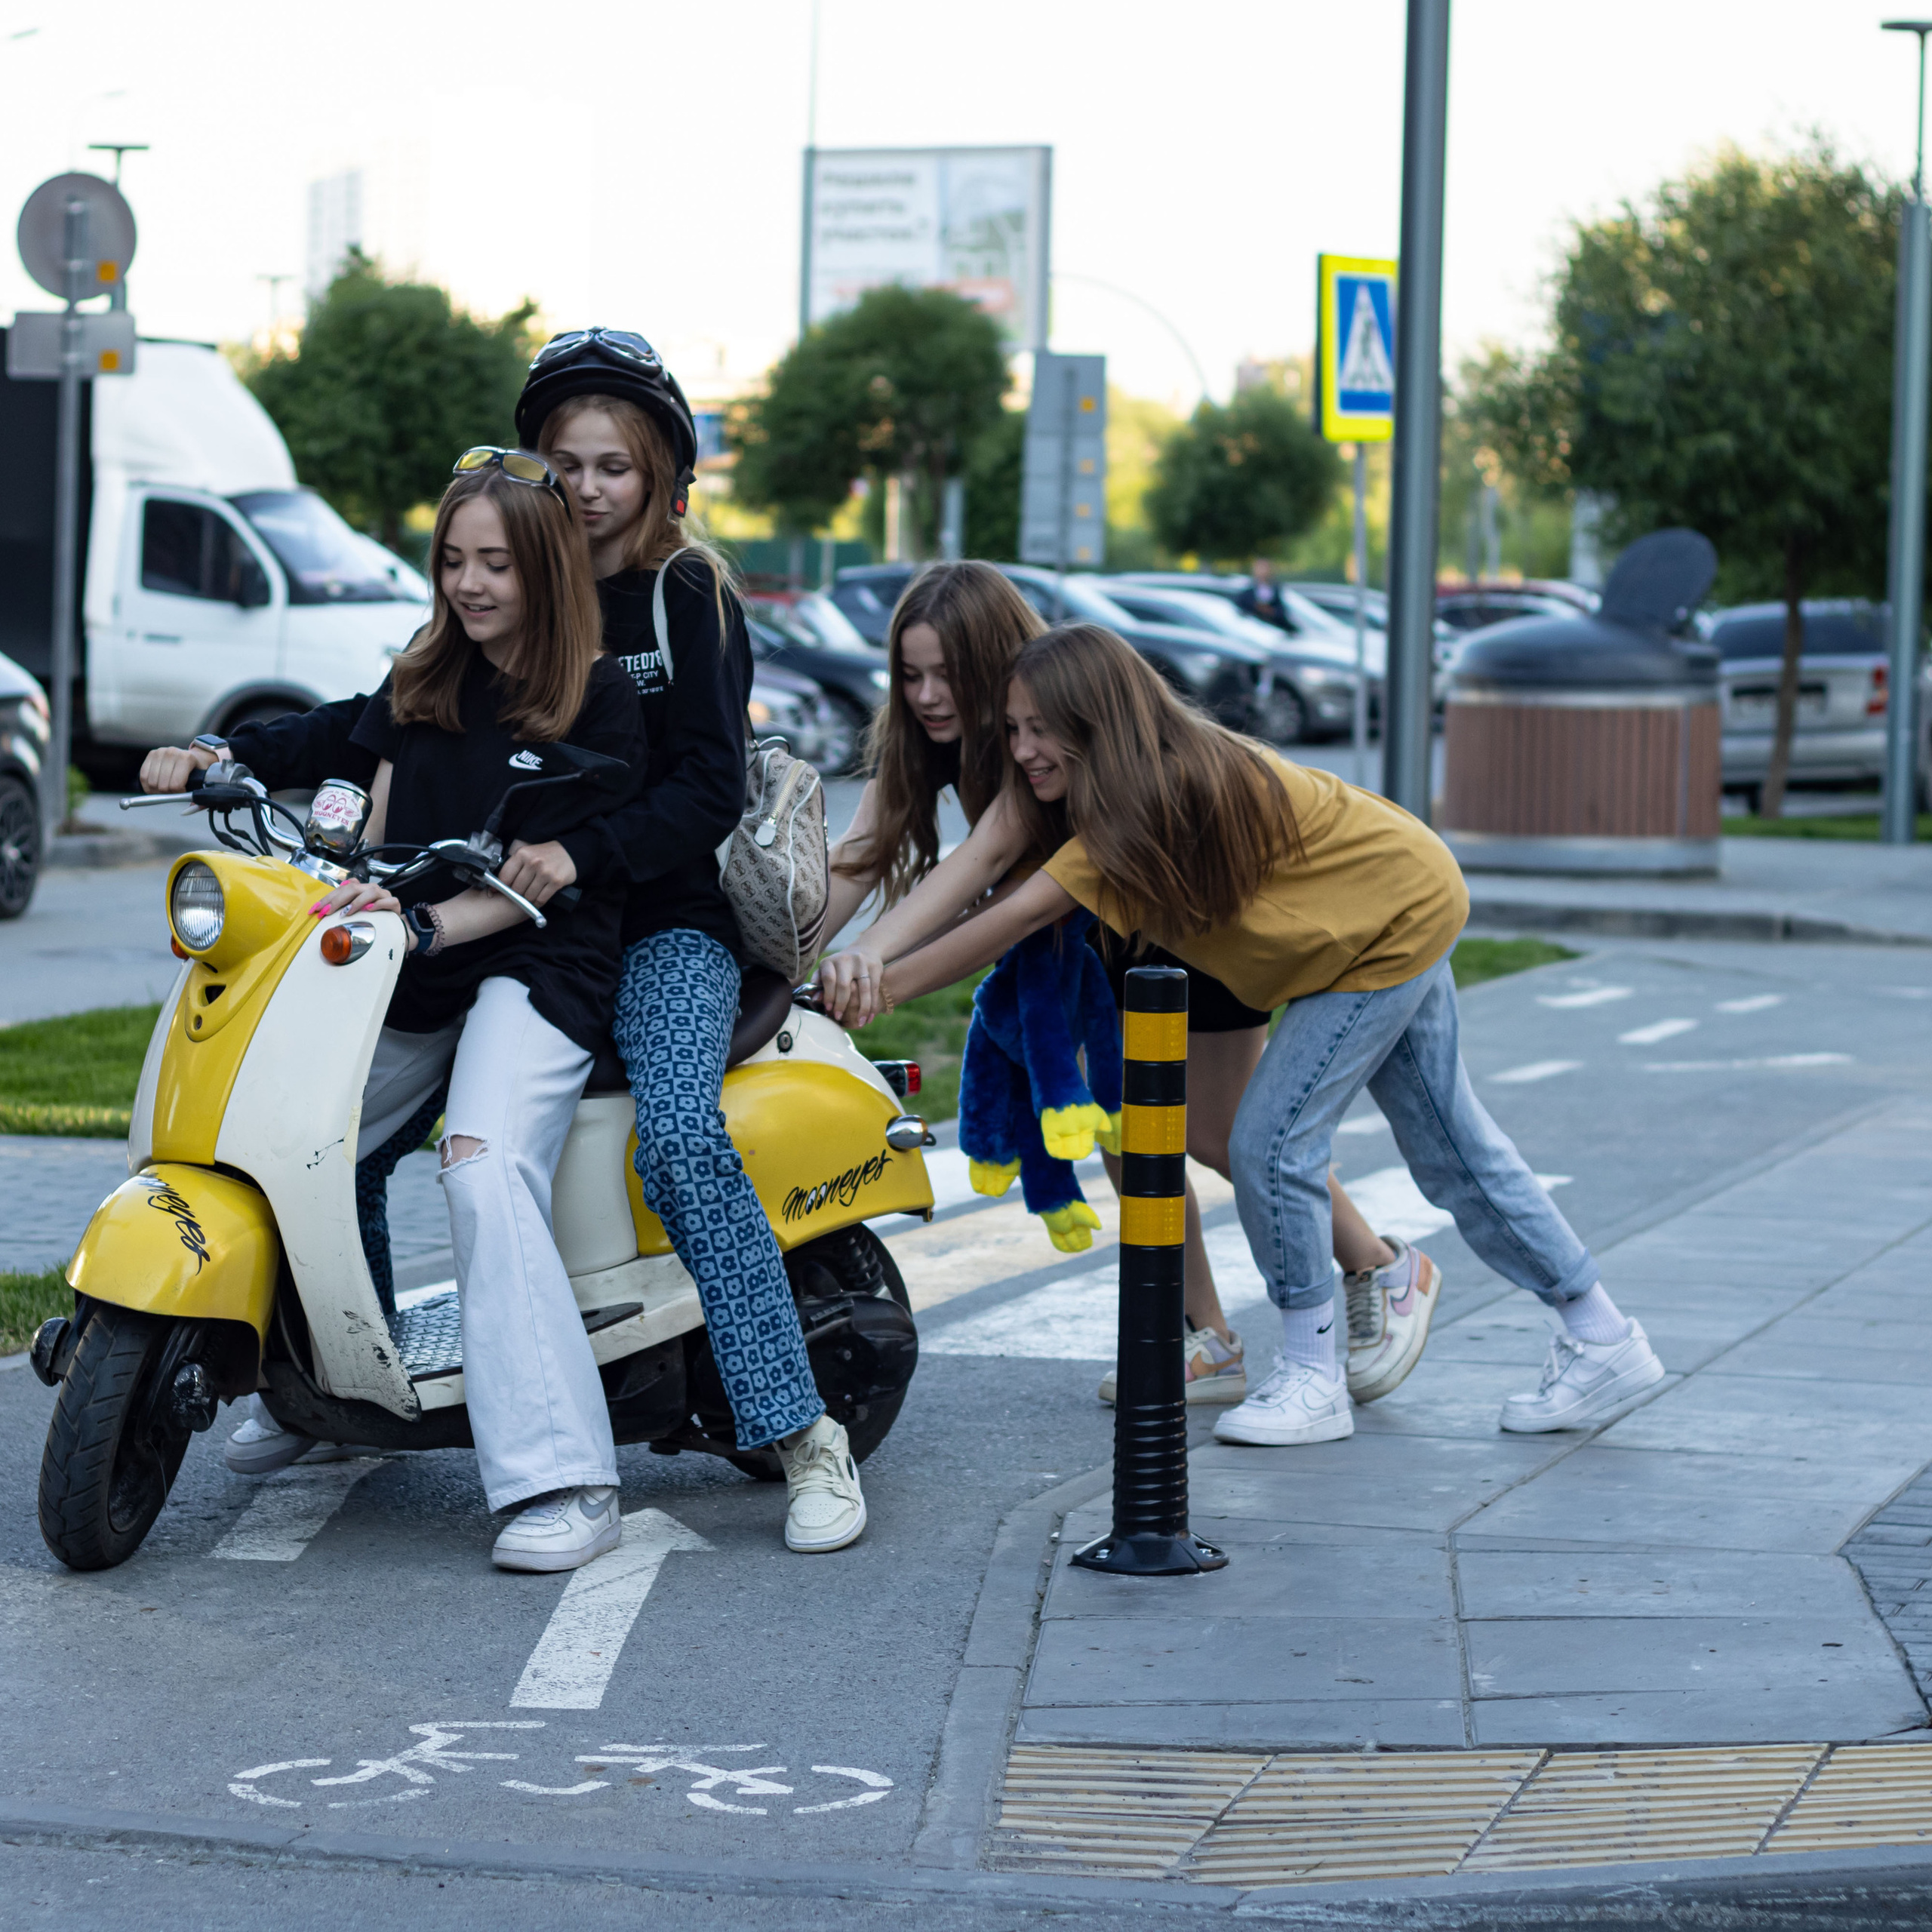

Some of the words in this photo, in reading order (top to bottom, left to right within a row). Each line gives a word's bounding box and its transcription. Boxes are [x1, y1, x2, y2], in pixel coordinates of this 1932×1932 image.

[643, 670, 660, 678] CITY
[518, 749, 543, 766] NIKE
[313, 810, 349, 826] MOONEYES
